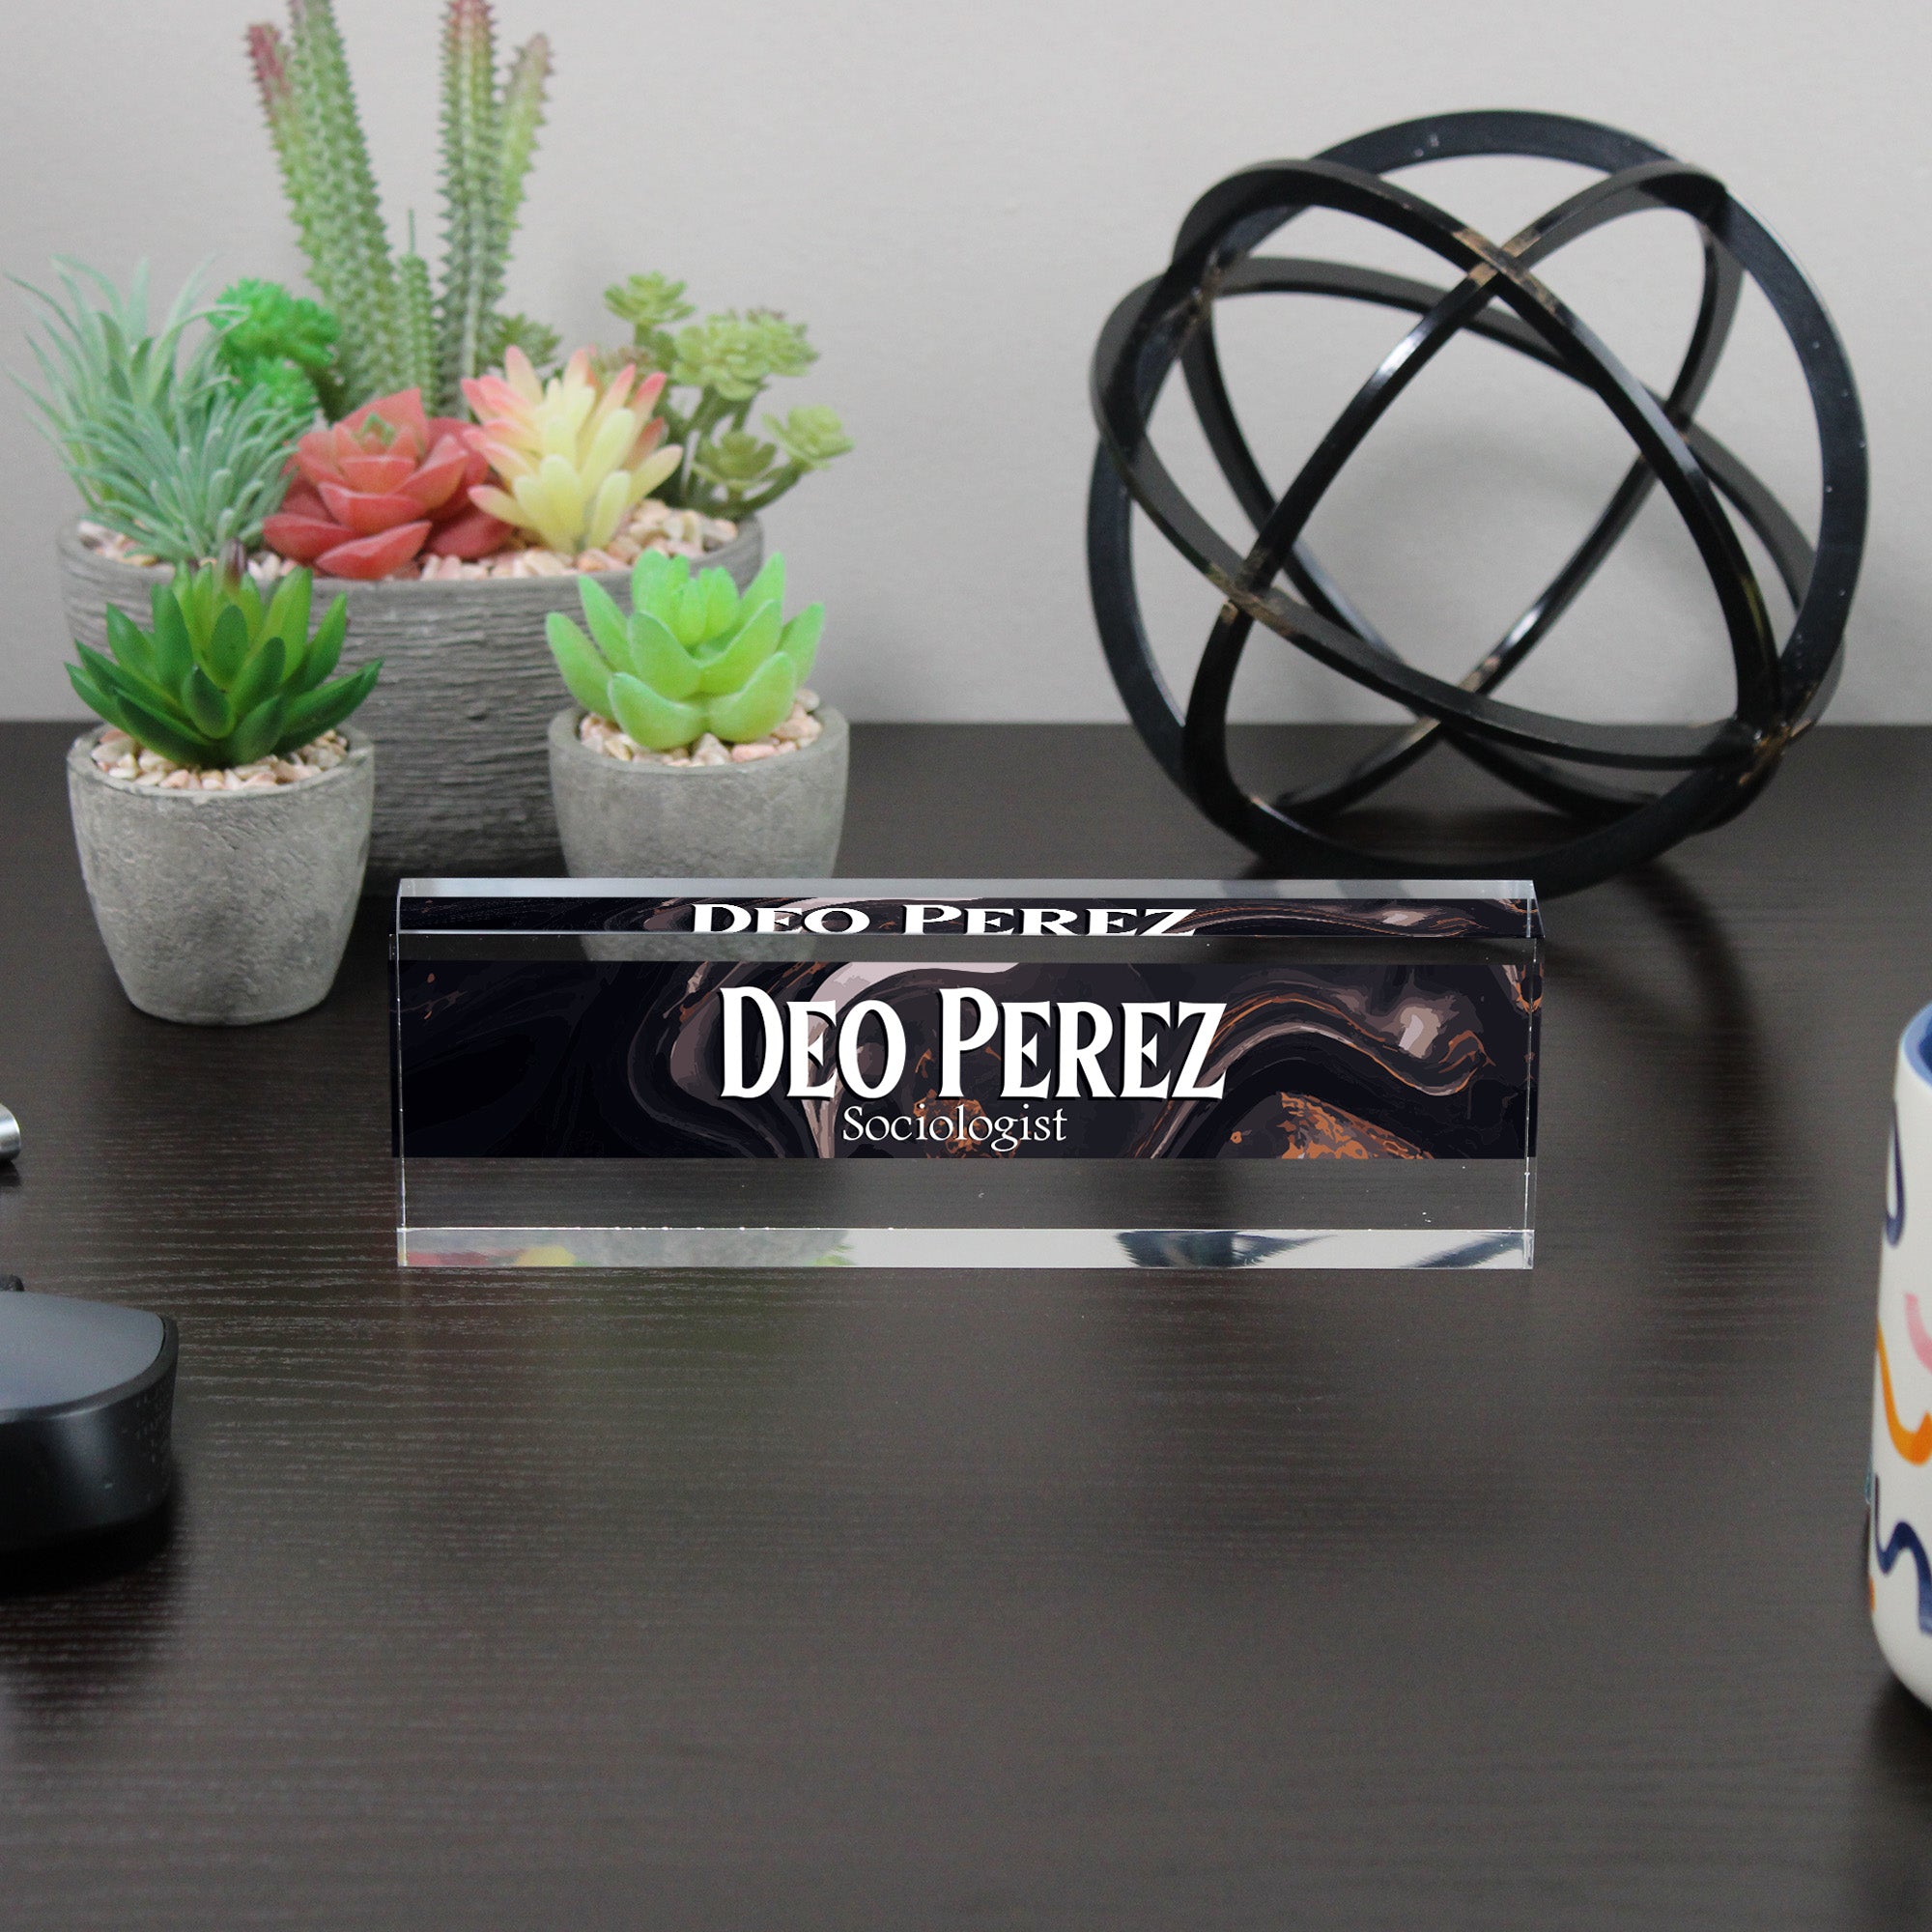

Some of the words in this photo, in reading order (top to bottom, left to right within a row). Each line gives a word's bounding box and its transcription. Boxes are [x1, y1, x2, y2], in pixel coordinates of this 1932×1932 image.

[903, 904, 1196, 936] PEREZ
[721, 986, 907, 1099] DEO
[940, 986, 1227, 1099] PEREZ
[842, 1102, 1066, 1153] Sociologist
